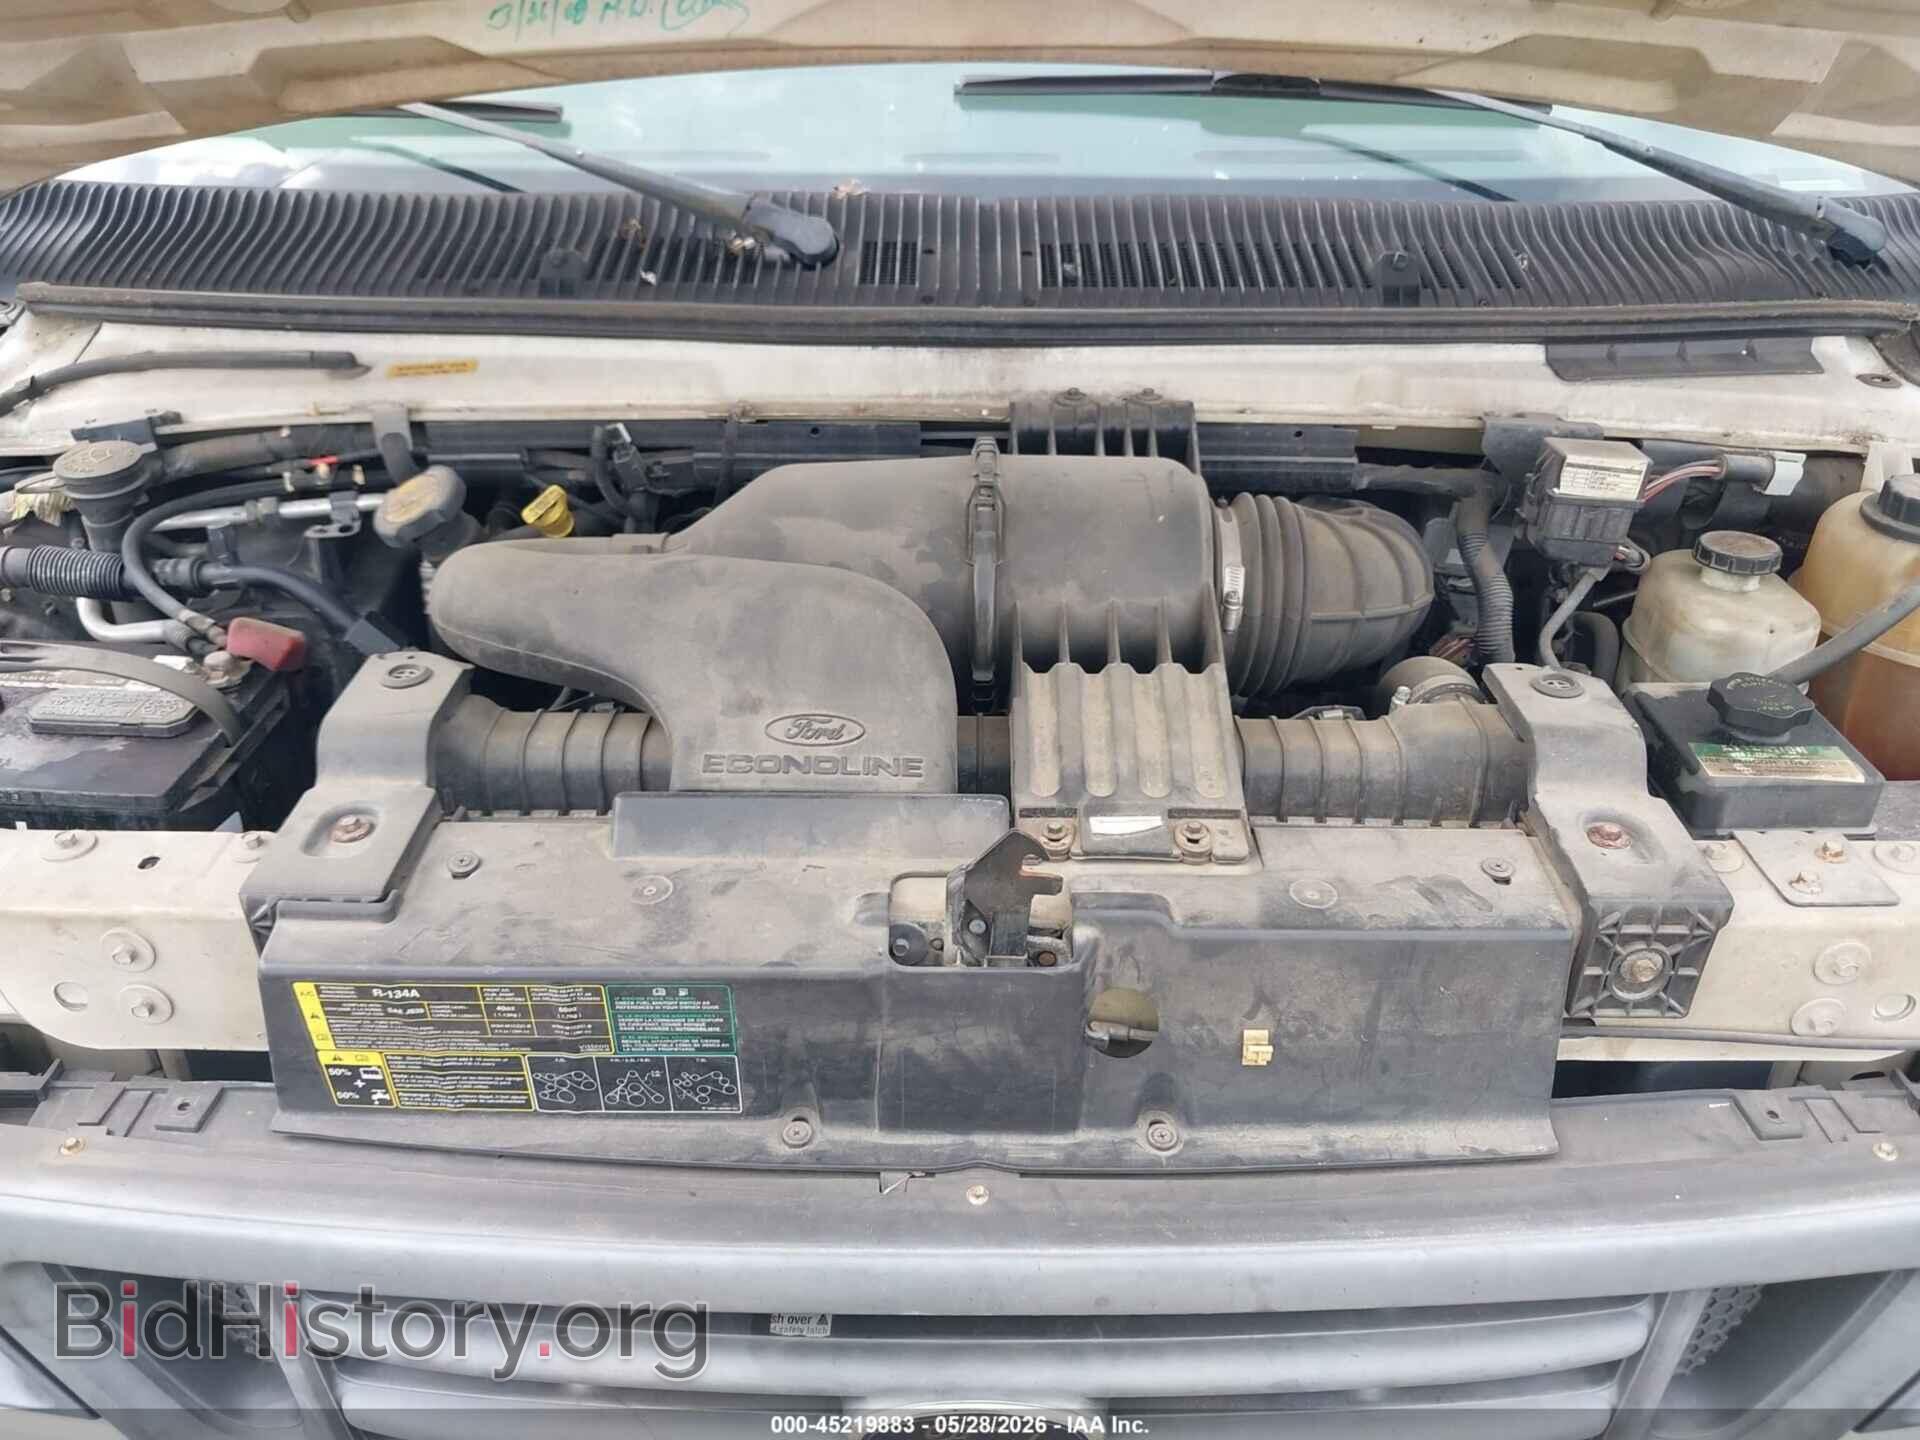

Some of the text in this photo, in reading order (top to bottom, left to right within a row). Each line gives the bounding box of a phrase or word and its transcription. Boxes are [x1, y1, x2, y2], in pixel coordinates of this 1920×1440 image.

[784, 717, 845, 741] Ford
[702, 754, 925, 778] ECONOLINE
[371, 988, 420, 999] R-134A
[787, 1315, 813, 1325] over
